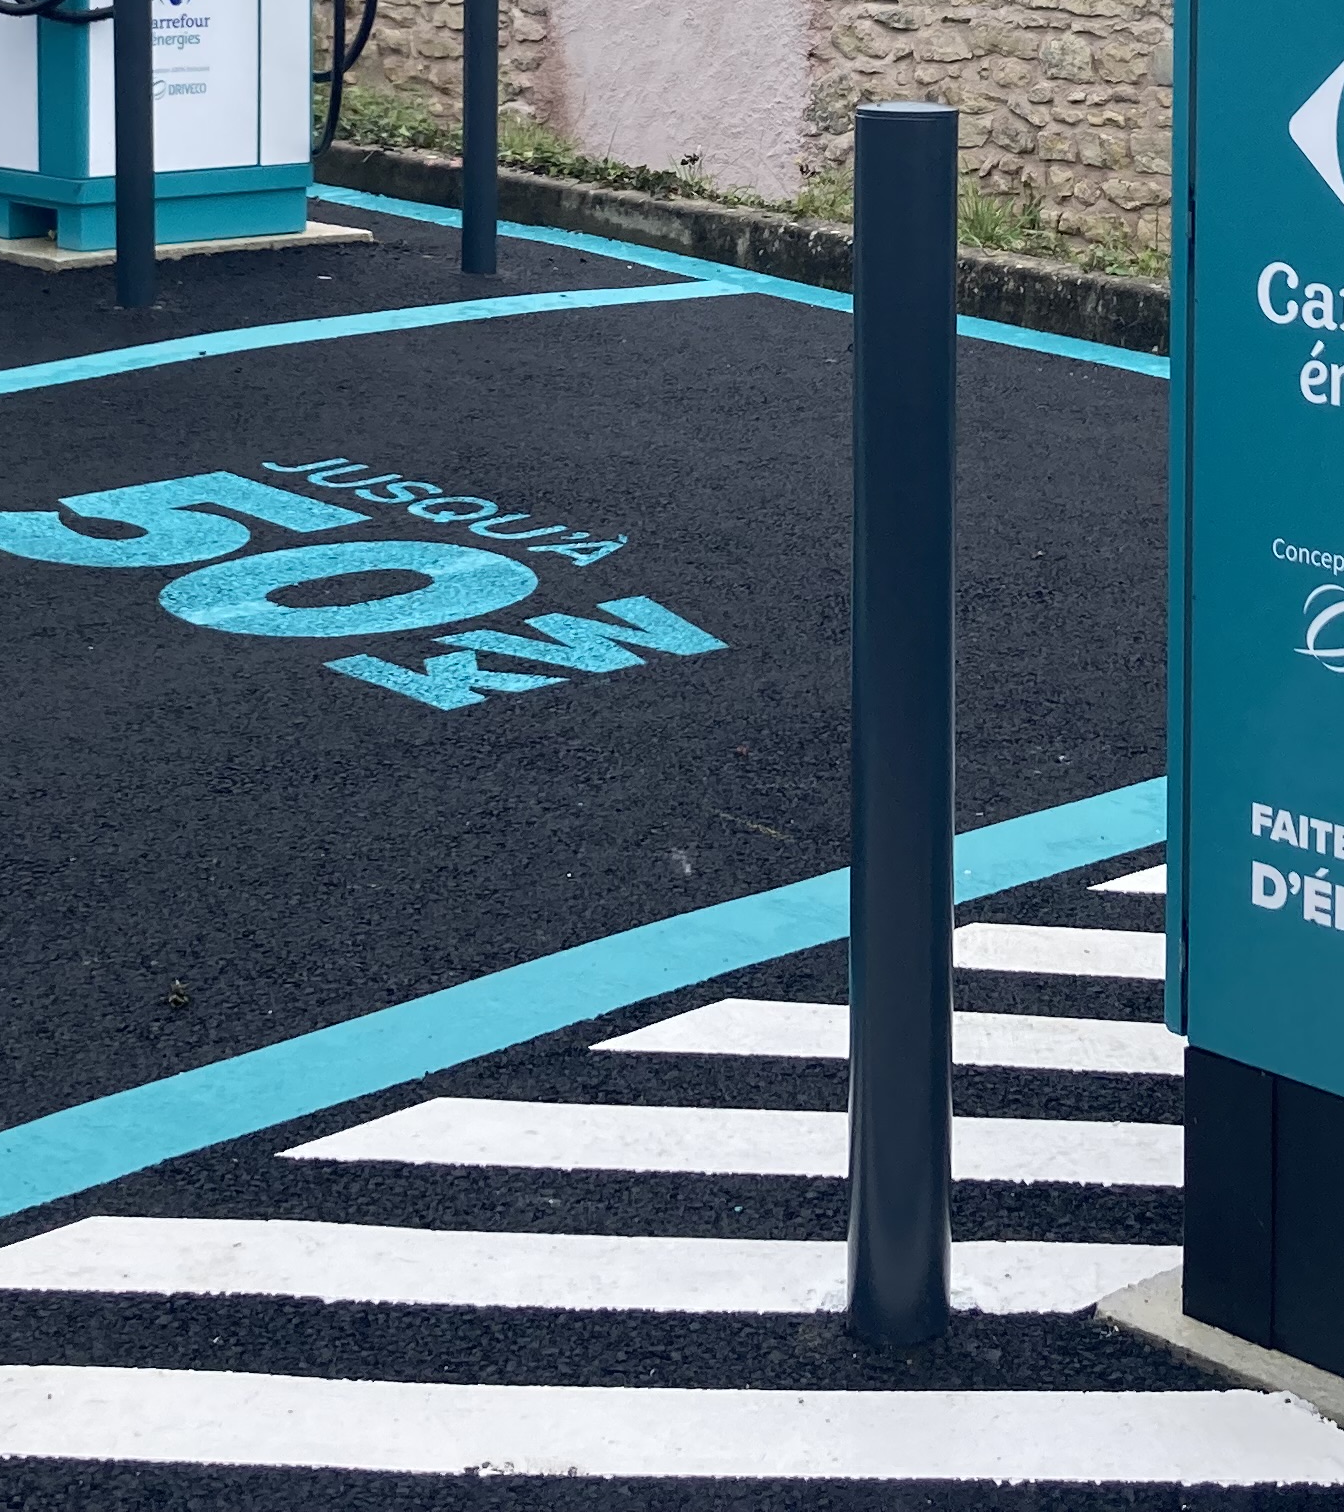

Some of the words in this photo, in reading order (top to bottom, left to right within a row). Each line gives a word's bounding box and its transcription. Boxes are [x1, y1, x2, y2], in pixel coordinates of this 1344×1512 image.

[152, 13, 211, 30] arrefour
[168, 82, 208, 96] DRIVECO
[261, 457, 631, 567] JUSQU'À
